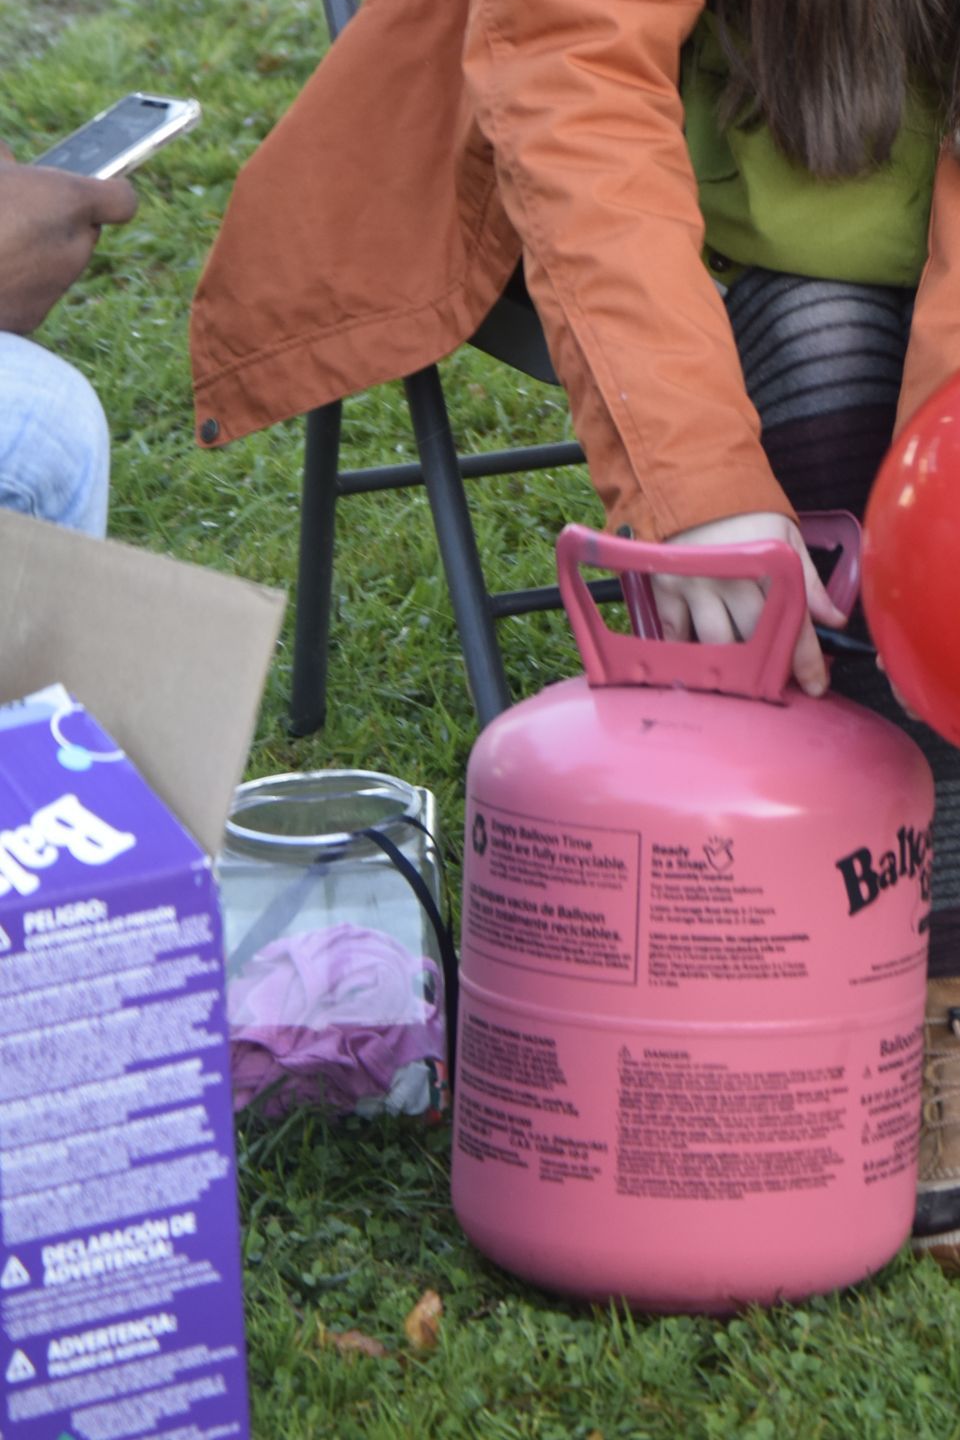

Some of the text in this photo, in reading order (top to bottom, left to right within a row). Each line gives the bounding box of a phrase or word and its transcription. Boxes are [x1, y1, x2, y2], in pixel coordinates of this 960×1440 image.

[0, 793, 137, 896] Bal
[519, 825, 560, 846] Balloon
[562, 834, 593, 851] Time
[532, 844, 556, 865] fully
[540, 900, 555, 917] de
[557, 904, 606, 924] Balloon
[169, 1210, 197, 1239] DE
